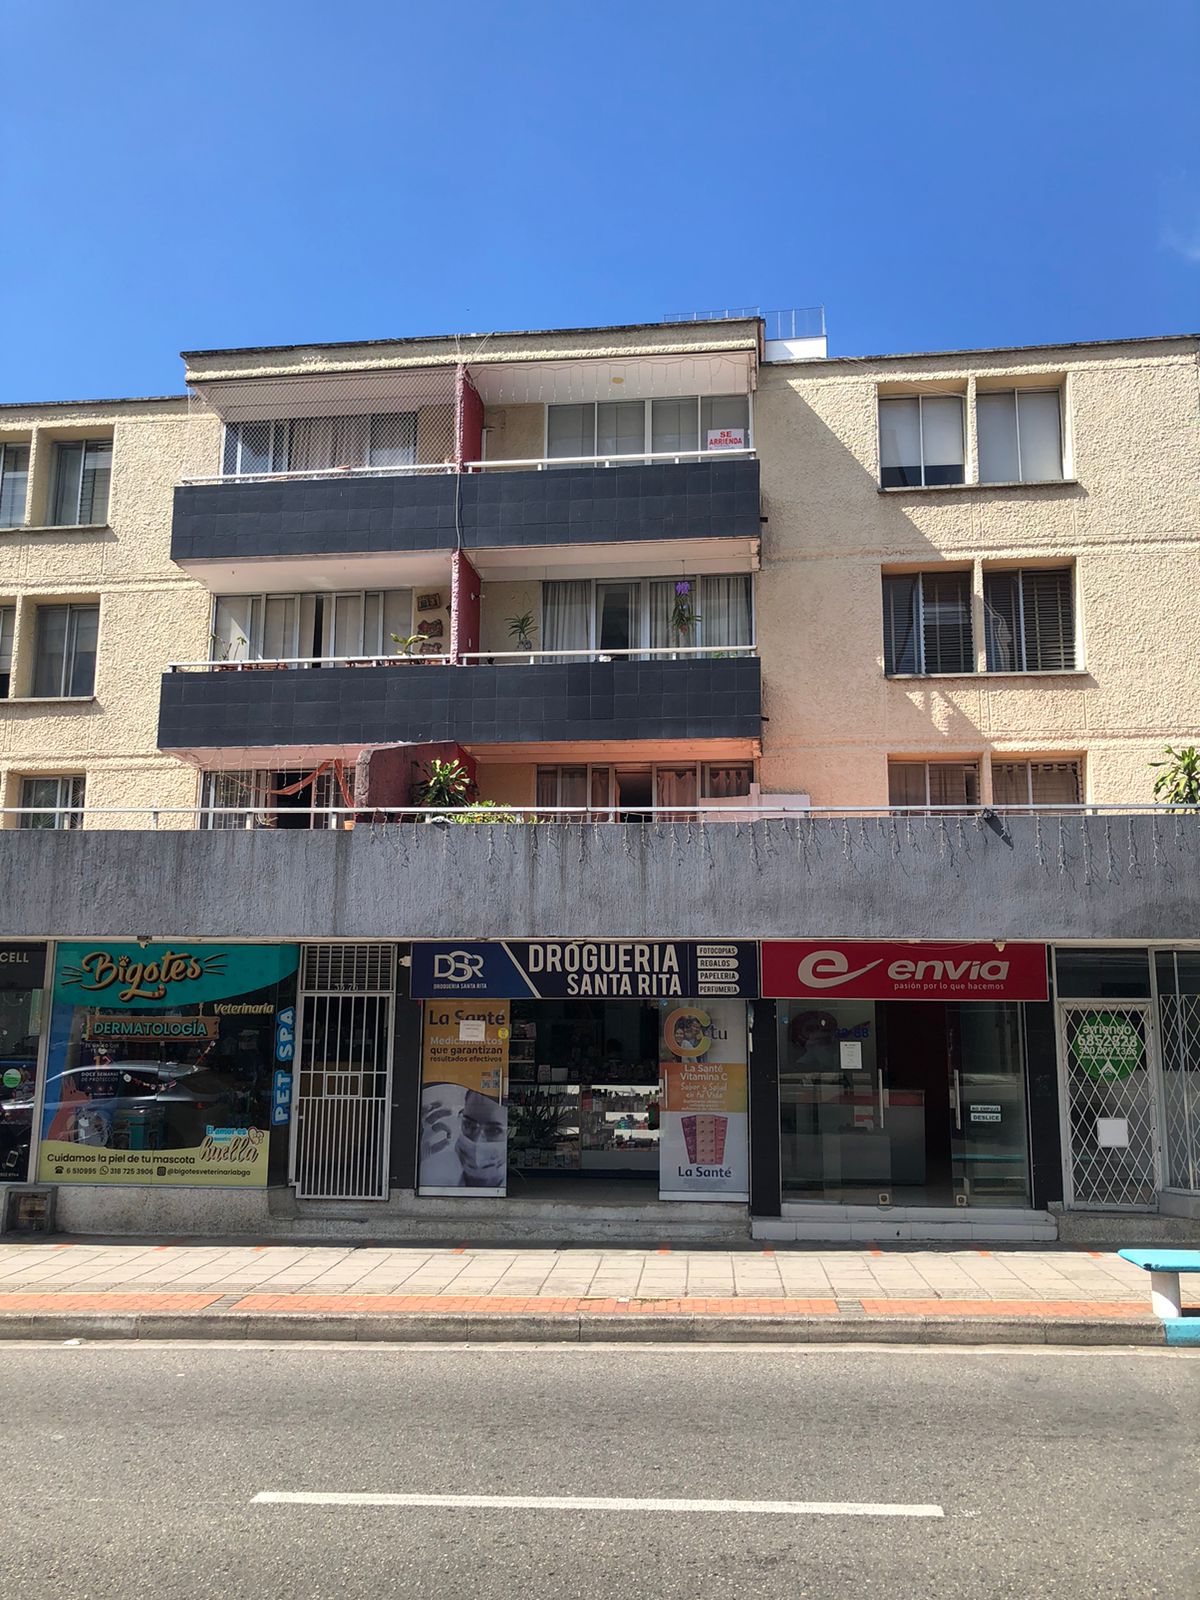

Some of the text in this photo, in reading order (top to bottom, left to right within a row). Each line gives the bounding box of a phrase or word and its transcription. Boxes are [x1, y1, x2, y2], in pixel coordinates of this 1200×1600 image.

[529, 944, 679, 972] DROGUERIA
[434, 951, 484, 982] DSR
[80, 951, 202, 1002] Bigotes
[700, 972, 736, 980] PAPELERIA
[567, 973, 682, 995] SANTA RITA
[894, 982, 921, 990] pasión
[968, 982, 1005, 990] hacemos
[214, 1003, 274, 1014] Veterinaria
[429, 1010, 449, 1025] La
[93, 1020, 208, 1035] DERMATOLOGÍA
[430, 1046, 503, 1056] que garantizan
[275, 1010, 294, 1122] PET SPA
[684, 1064, 723, 1072] La Santé
[721, 1073, 728, 1081] C
[200, 1136, 259, 1163] huella
[47, 1154, 195, 1165] Cuidamos la piel de tu mascota
[678, 1166, 732, 1178] La Santé
